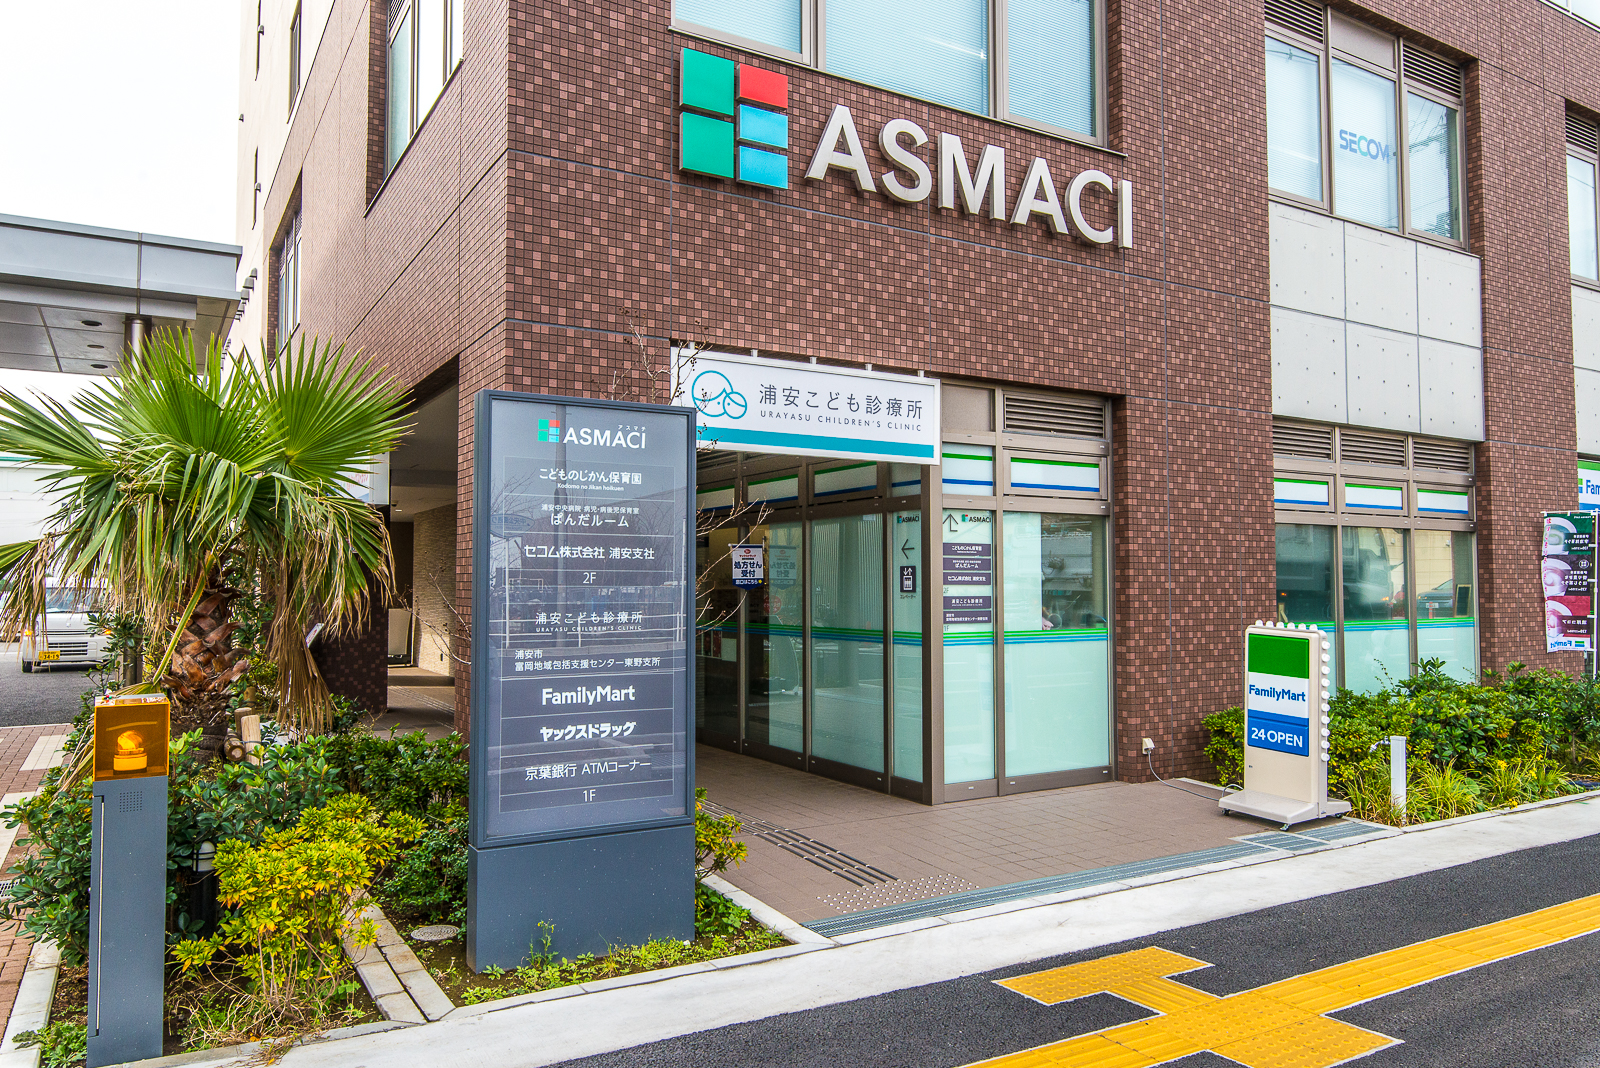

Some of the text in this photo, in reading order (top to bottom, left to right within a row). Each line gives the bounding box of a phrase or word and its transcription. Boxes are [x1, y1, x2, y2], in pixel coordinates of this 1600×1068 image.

[804, 104, 1133, 249] ASMACI
[759, 383, 922, 420] 浦安こども診療所
[618, 424, 646, 432] アスマチ
[760, 410, 922, 432] URAYASU CHILDREN'S CLINIC
[562, 427, 646, 449] ASMACI
[539, 468, 642, 485] こどものじかん保育園
[541, 503, 582, 513] 浦安中央病院
[550, 512, 630, 528] ぱんだルーム
[902, 515, 920, 523] ASMACI
[523, 544, 655, 560] セコム株式会社 浦安支社
[733, 560, 763, 570] 処方せん
[582, 572, 597, 584] 2F
[740, 569, 756, 578] 受付
[535, 611, 643, 625] 浦安こども診療所
[514, 649, 543, 660] 浦安市
[514, 656, 661, 672] 富岡地域包括支援センター東野支所
[541, 685, 636, 706] FamilyMart
[1248, 684, 1306, 702] FamilyMart
[539, 721, 637, 742] ヤックスドラッグ
[524, 759, 652, 781] 京葉銀行 ATMコーナー
[582, 789, 596, 802] 1F
